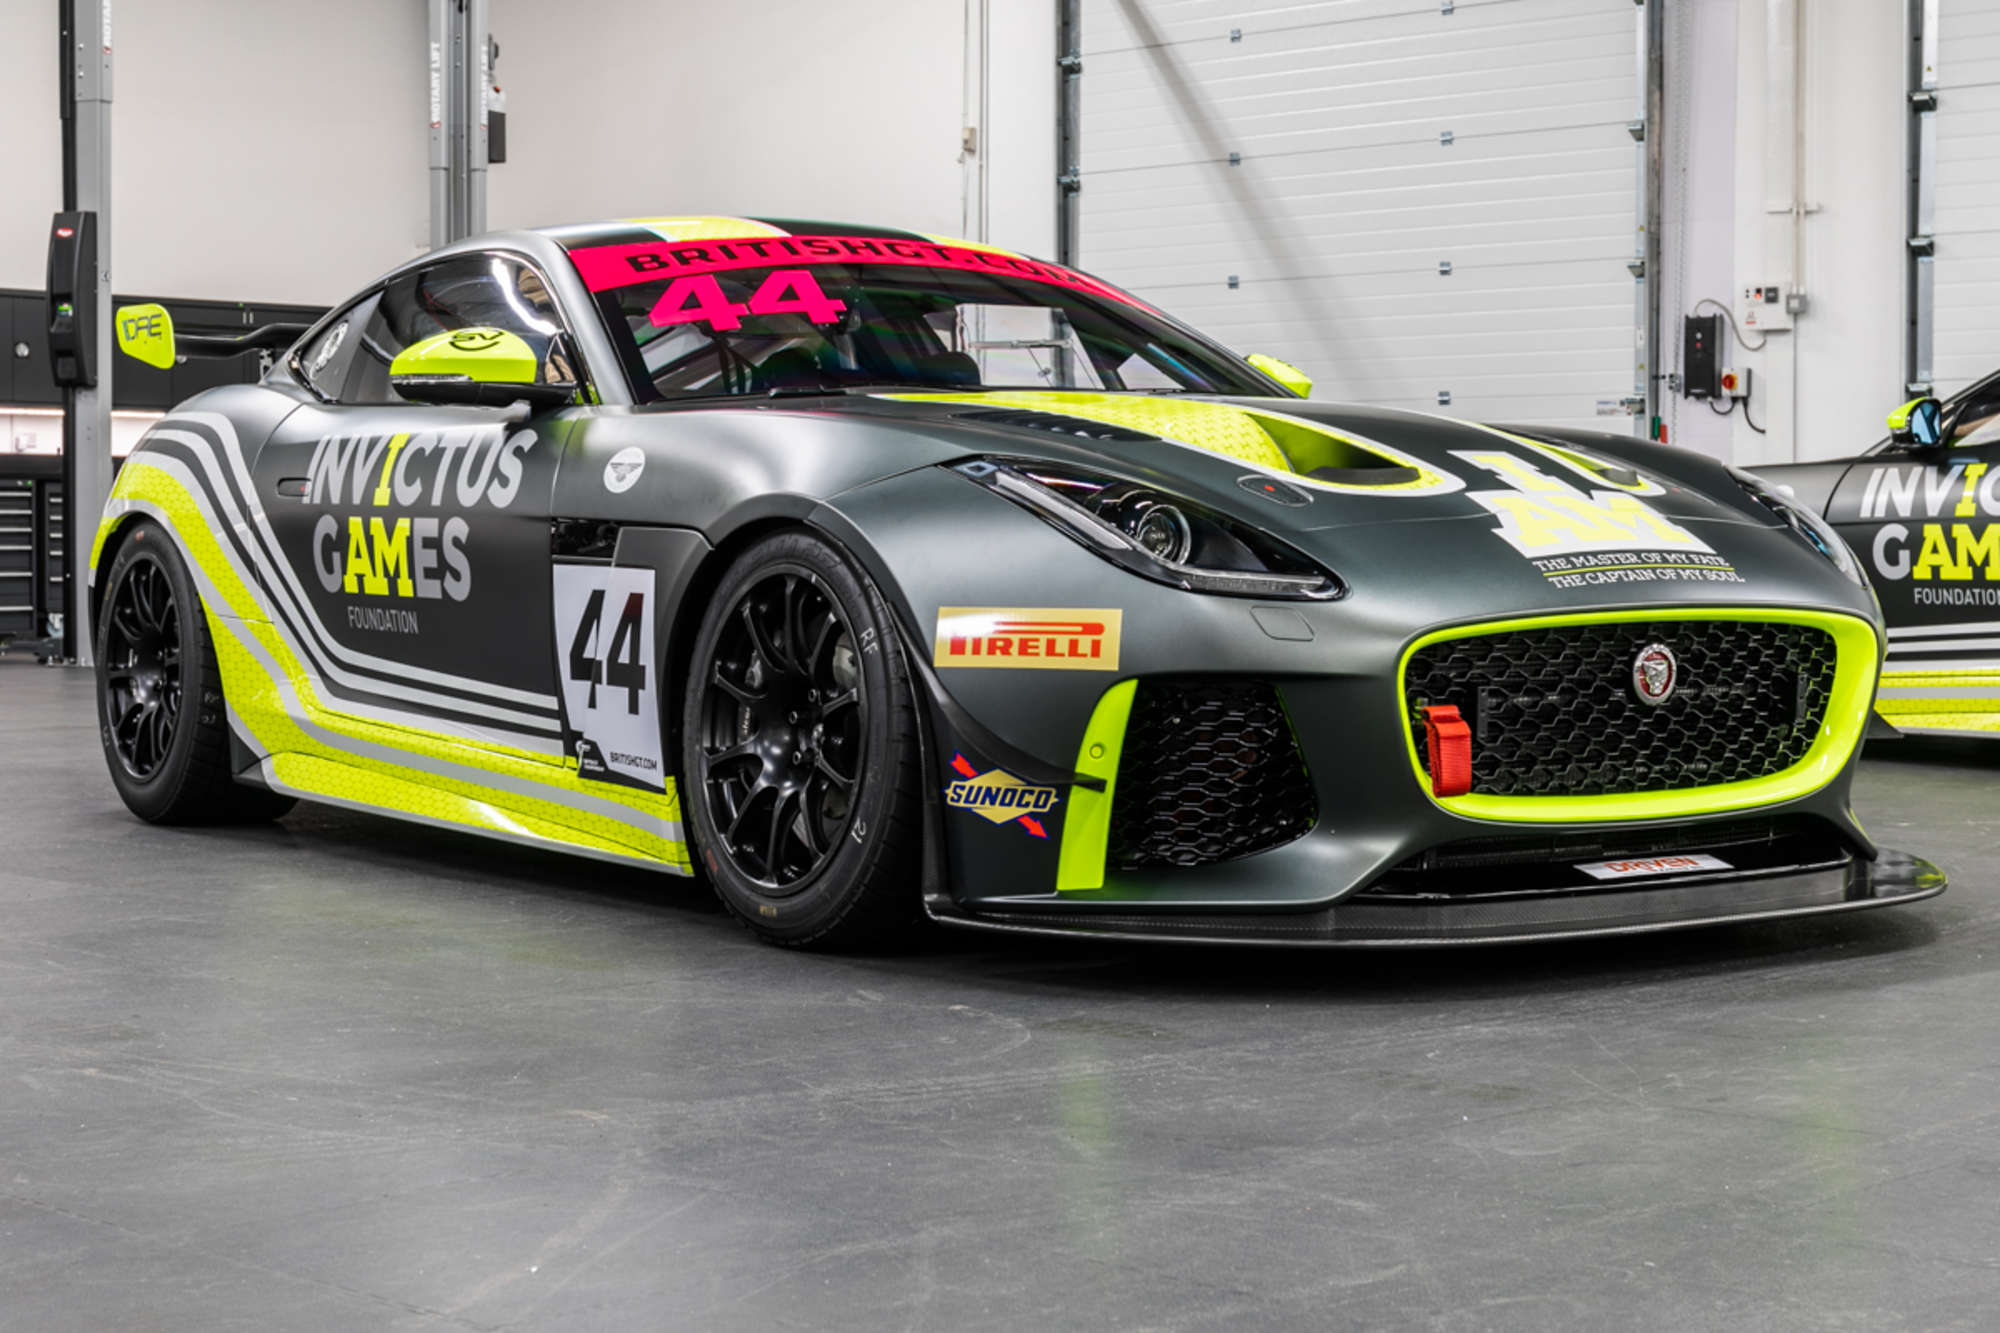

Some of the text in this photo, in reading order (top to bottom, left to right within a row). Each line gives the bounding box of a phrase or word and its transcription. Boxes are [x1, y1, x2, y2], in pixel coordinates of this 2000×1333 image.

[648, 269, 847, 332] 44
[302, 429, 538, 508] INVICTUS
[1480, 491, 1702, 551] AM
[313, 514, 471, 602] GAMES
[1532, 552, 1730, 572] THE MASTER OF MY FATE
[1548, 568, 1746, 589] THE CAPTAIN OF MY SOUL
[1913, 587, 2000, 606] FOUNDATIO
[348, 606, 419, 634] FOUNDATION
[569, 589, 646, 716] 44
[949, 621, 1105, 659] PIRELLI
[949, 784, 1053, 809] SUNOCO
[1604, 856, 1701, 872] DRIVEN
